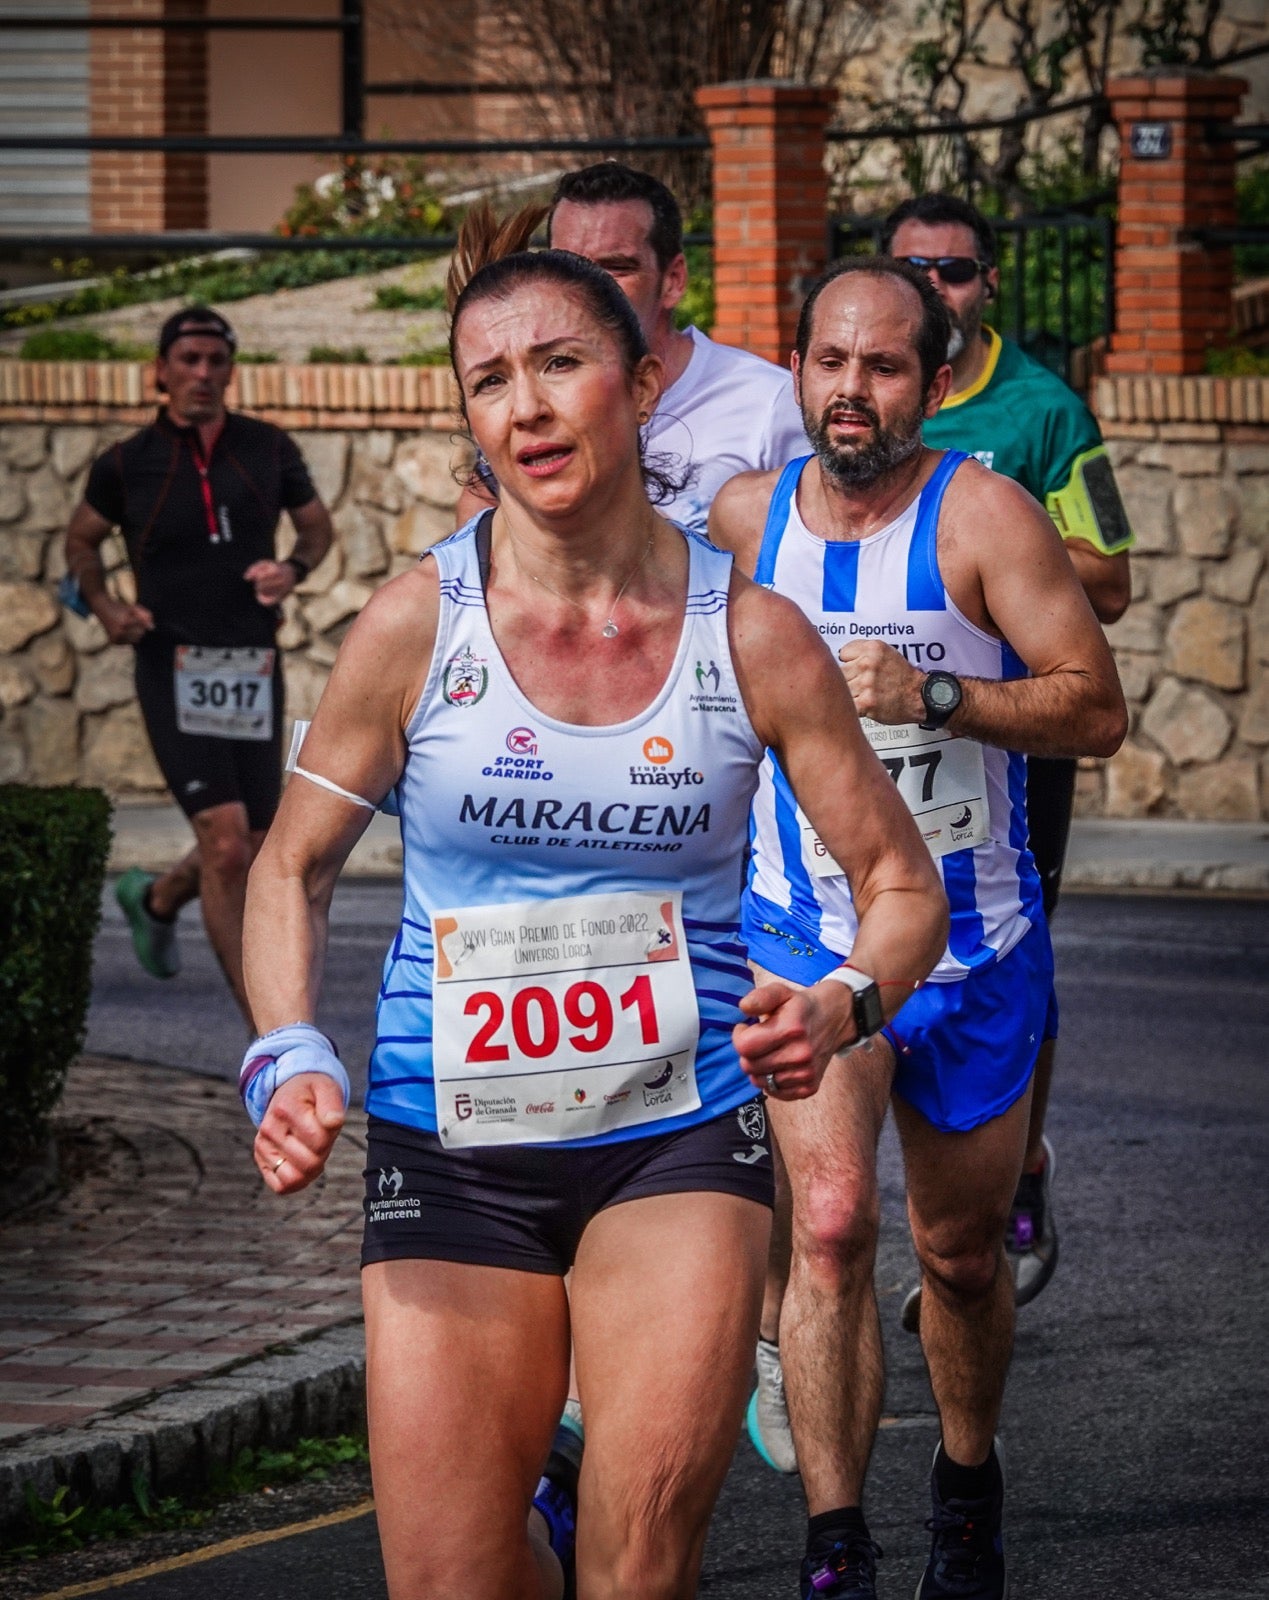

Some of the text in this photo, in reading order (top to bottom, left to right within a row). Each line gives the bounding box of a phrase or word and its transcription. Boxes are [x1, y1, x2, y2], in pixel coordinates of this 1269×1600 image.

[849, 622, 915, 638] Deportiva
[190, 679, 259, 708] 3017
[689, 694, 737, 704] Ayuntamiento
[699, 703, 737, 713] Maracena
[494, 756, 545, 770] SPORT
[630, 765, 667, 776] grupo
[482, 766, 554, 782] GARRIDO
[630, 767, 705, 790] mayfo
[459, 794, 711, 836] MARACENA
[490, 834, 683, 853] CLUB DE ATLETISMO
[490, 927, 516, 947] GRAN
[519, 923, 560, 944] PREMIO
[563, 921, 577, 939] DE
[581, 918, 616, 937] FONDO
[619, 912, 650, 934] 2022
[514, 941, 593, 965] UNIVERSO LORCA
[463, 974, 660, 1065] 2091
[474, 1096, 516, 1107] Diputación
[475, 1105, 517, 1116] de Granada
[370, 1197, 421, 1212] Ayuntamiento
[374, 1208, 421, 1222] Maracena
